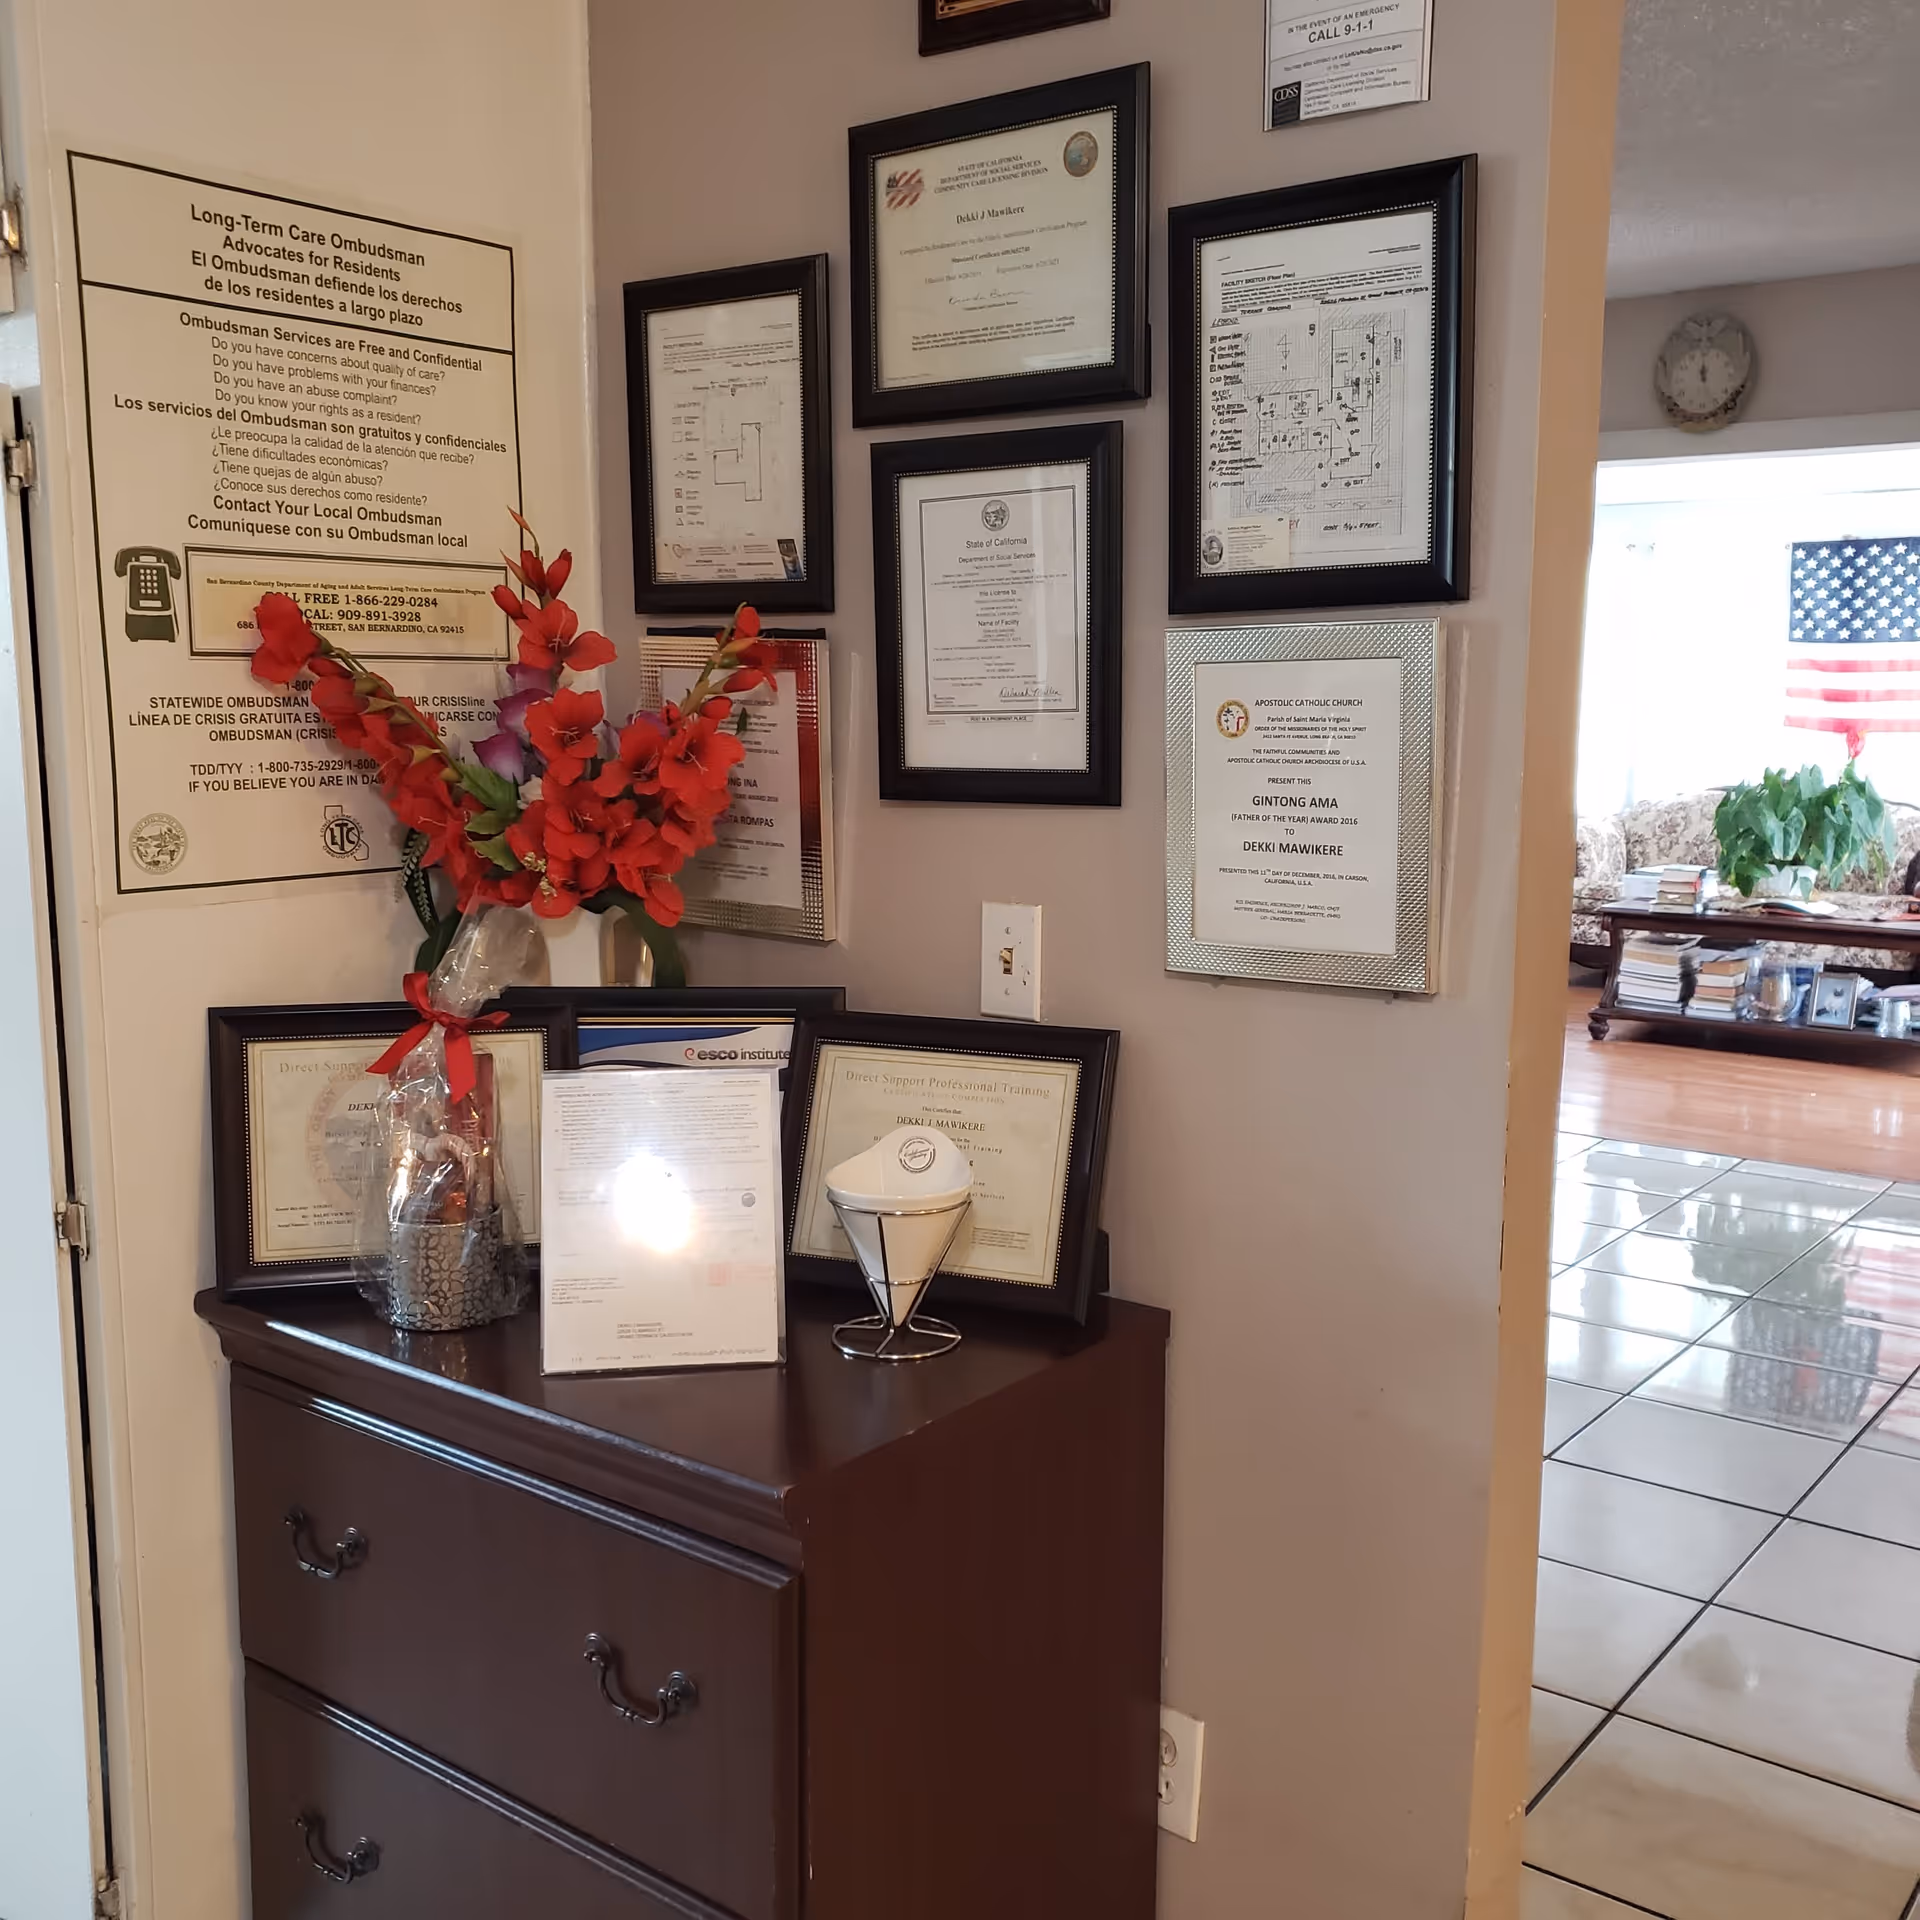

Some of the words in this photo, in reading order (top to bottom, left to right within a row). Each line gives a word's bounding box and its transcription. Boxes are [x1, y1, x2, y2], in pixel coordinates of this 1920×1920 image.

[1295, 23, 1307, 31] THE
[1309, 17, 1331, 28] EVENT
[1332, 15, 1342, 23] OF
[1343, 12, 1353, 20] AN
[1354, 3, 1399, 18] EMERGENCY
[1308, 26, 1341, 43] CALL
[1344, 18, 1374, 36] 9-1-1
[955, 211, 978, 224] Dekki
[980, 210, 984, 220] J
[191, 203, 283, 237] Long-Term
[288, 224, 325, 245] Care
[330, 233, 424, 266] Ombudsman
[223, 235, 304, 263] Advocates
[308, 250, 329, 267] for
[333, 255, 400, 281] Residents
[192, 250, 206, 267] El
[211, 254, 310, 285] Ombudsman
[314, 274, 375, 297] defiende
[379, 285, 398, 301] los
[401, 290, 462, 313] derechos
[204, 275, 222, 291] de
[227, 278, 250, 296] los
[256, 287, 334, 310] residentes
[339, 301, 346, 312] a
[351, 300, 385, 321] largo
[389, 308, 423, 326] plazo
[180, 312, 268, 338] Ombudsman
[273, 327, 331, 347] Services
[335, 339, 355, 350] are
[359, 339, 385, 355] Free
[388, 347, 409, 360] and
[413, 349, 481, 371] Confidential
[211, 335, 228, 350] Do
[230, 341, 251, 354] you
[255, 343, 283, 358] have
[286, 350, 337, 365] concerns
[340, 355, 369, 370] about
[372, 362, 404, 378] quality
[406, 366, 416, 377] of
[418, 370, 445, 381] care?
[114, 394, 143, 410] Los
[148, 401, 212, 418] servicios
[216, 407, 236, 421] del
[240, 410, 327, 431] Ombudsman
[331, 423, 354, 435] son
[358, 426, 411, 441] gratuitos
[414, 433, 421, 445] y
[425, 434, 506, 452] confidenciales
[213, 494, 271, 513] Contact
[274, 499, 309, 516] Your
[314, 503, 352, 519] Local
[357, 506, 442, 526] Ombudsman
[295, 525, 321, 537] con
[326, 528, 343, 538] su
[348, 526, 434, 545] Ombudsman
[438, 532, 467, 547] local
[965, 540, 984, 549] State
[985, 538, 993, 547] of
[994, 537, 1027, 546] California
[304, 592, 339, 604] FREE
[344, 594, 438, 608] 1-866-229-0284
[337, 609, 421, 622] 909-891-3928
[236, 620, 254, 629] 686
[347, 623, 365, 631] SAN
[367, 624, 425, 633] BERNARDINO,
[427, 625, 438, 633] CA
[439, 625, 464, 633] 92415
[149, 696, 223, 708] STATEWIDE
[226, 695, 308, 708] OMBUDSMAN
[431, 696, 484, 706] CRISISline
[1295, 698, 1330, 707] CATHOLIC
[173, 714, 191, 725] DE
[195, 713, 235, 725] CRISIS
[239, 712, 302, 724] GRATUITA
[743, 778, 758, 788] INA
[1252, 795, 1306, 807] GINTONG
[1309, 797, 1338, 808] AMA
[740, 815, 774, 827] ROMPAS
[1231, 813, 1260, 821] (FATHER
[1261, 814, 1271, 822] OF
[1272, 814, 1286, 822] THE
[1287, 815, 1308, 824] YEAR)
[1310, 816, 1338, 824] AWARD
[1340, 817, 1358, 825] 2016
[329, 823, 356, 851] LTC
[1243, 841, 1275, 852] DEKKI
[1279, 842, 1343, 856] MAWIKERE
[697, 1050, 738, 1060] esco
[740, 1047, 790, 1060] institute
[846, 1070, 878, 1082] Direct
[882, 1073, 925, 1087] Support
[929, 1077, 998, 1094] Professional
[1002, 1082, 1051, 1099] Training
[896, 1115, 924, 1126] DEKKI
[927, 1118, 932, 1126] J
[935, 1119, 986, 1132] MAWIKERE
